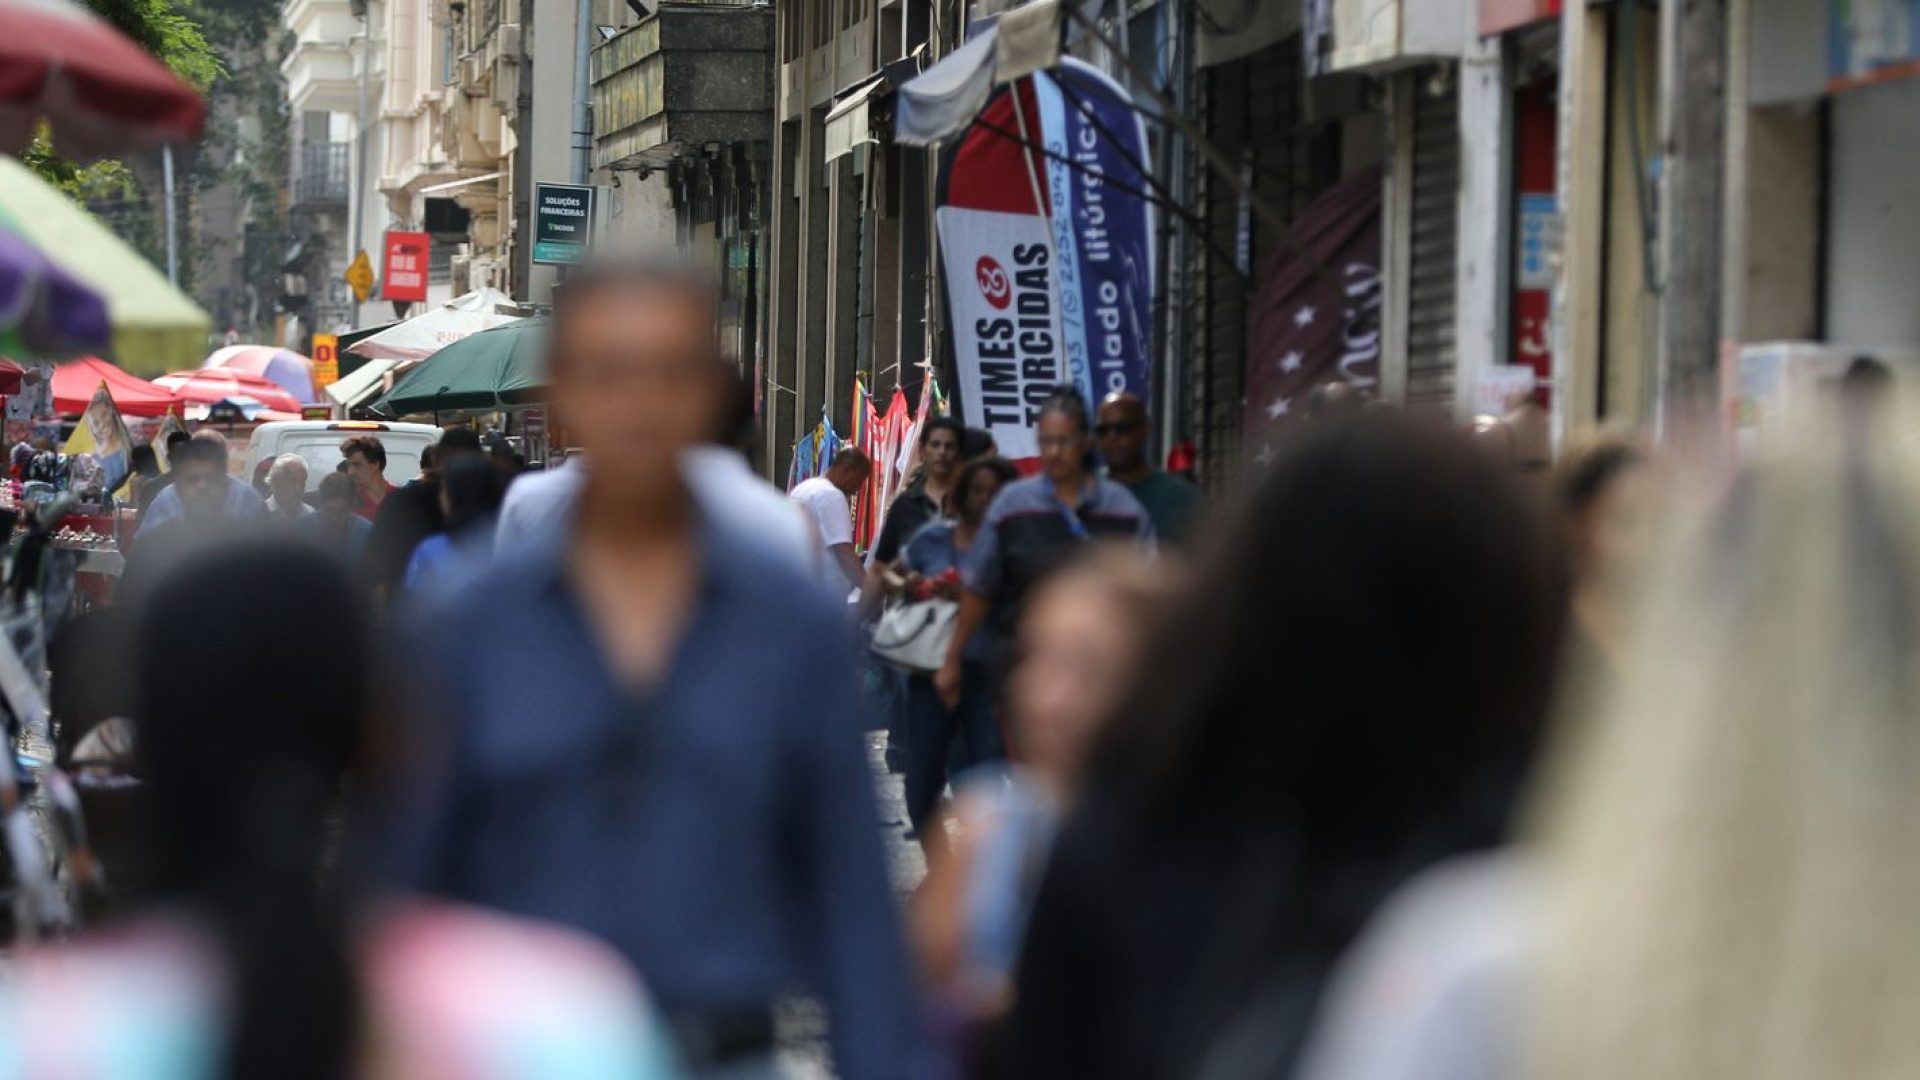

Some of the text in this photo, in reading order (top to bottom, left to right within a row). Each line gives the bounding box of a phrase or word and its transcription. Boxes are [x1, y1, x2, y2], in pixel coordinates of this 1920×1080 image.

[540, 207, 585, 217] FINANCEIRAS
[545, 196, 581, 206] SOLUÇÕES
[1013, 243, 1057, 428] TORCIDAS
[976, 317, 1020, 428] TIMES
